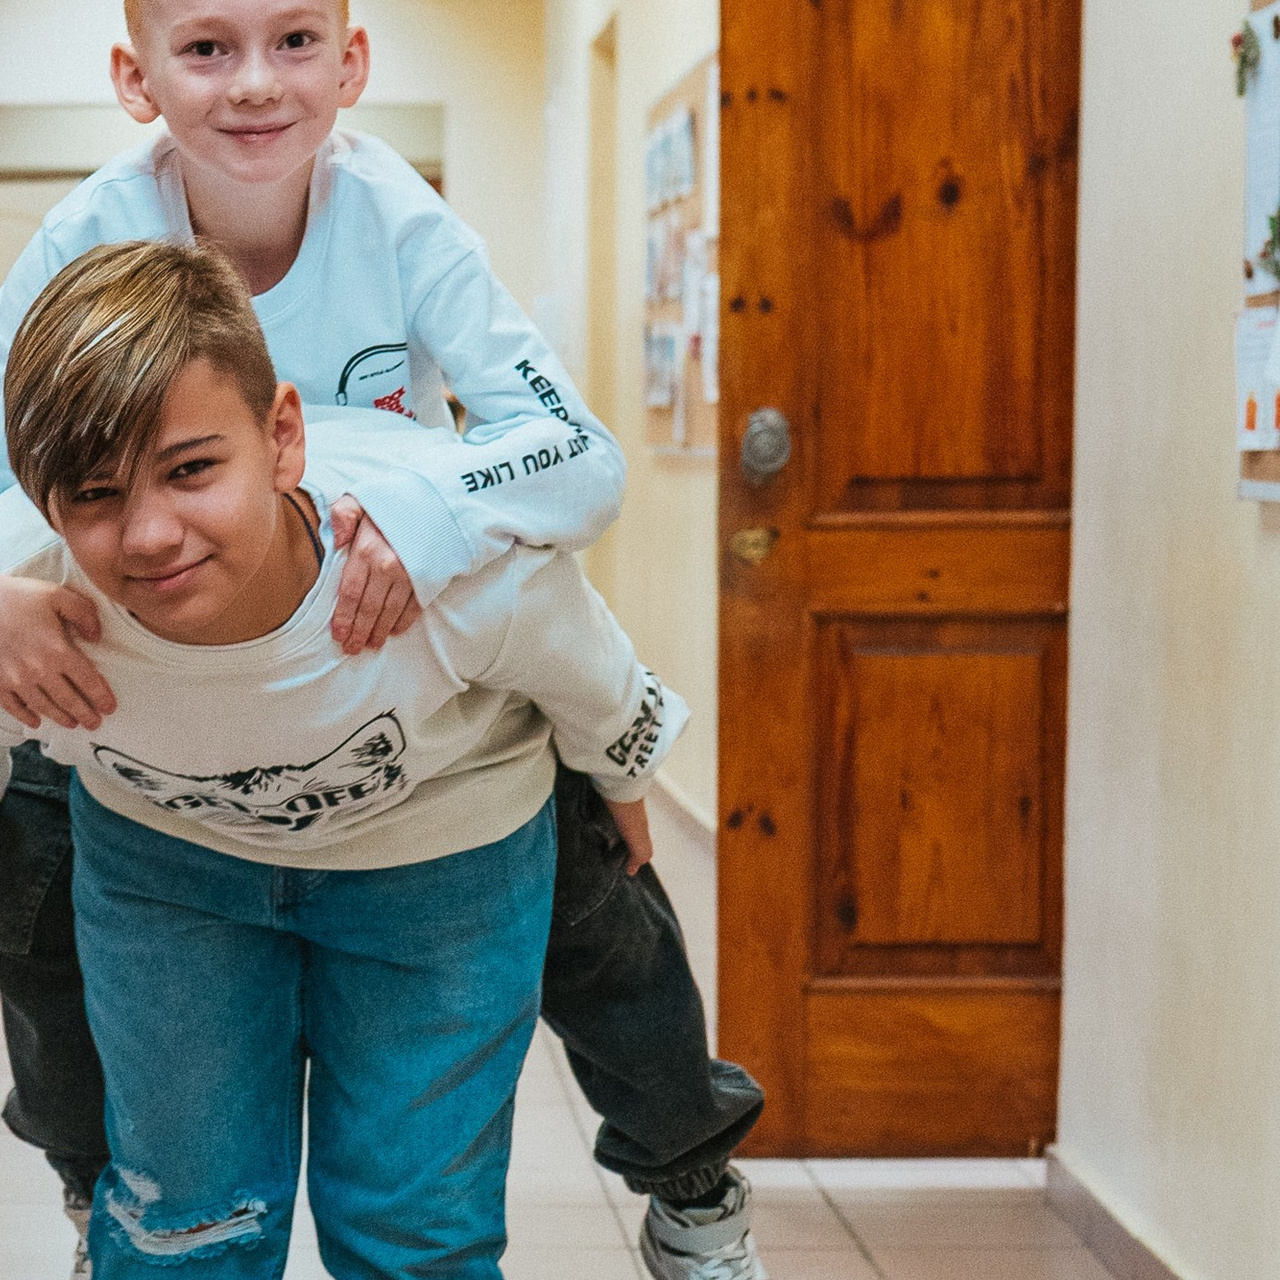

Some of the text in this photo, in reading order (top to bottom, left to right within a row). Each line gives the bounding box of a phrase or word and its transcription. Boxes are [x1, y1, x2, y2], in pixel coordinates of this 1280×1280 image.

[514, 359, 569, 421] KEEP
[522, 445, 564, 475] YOU
[460, 461, 515, 493] LIKE
